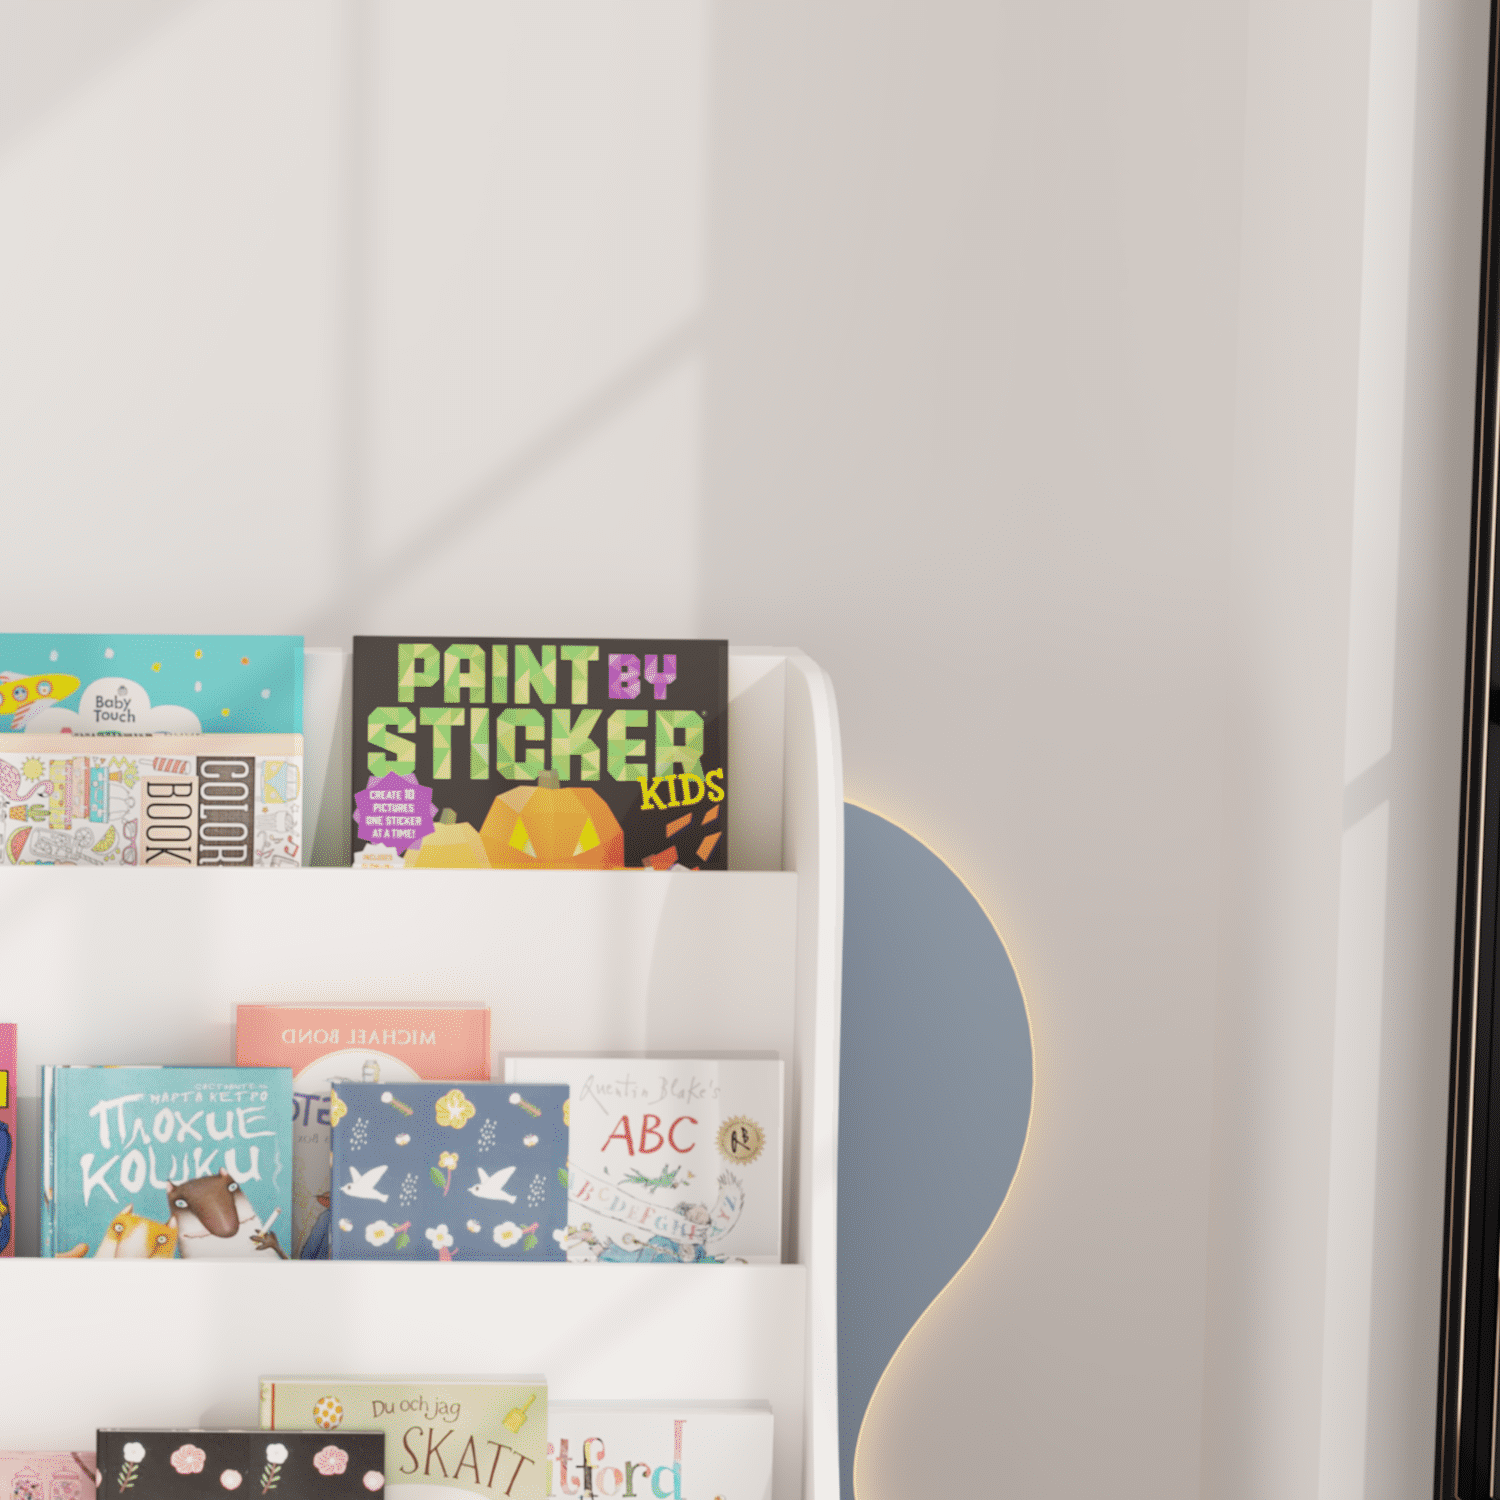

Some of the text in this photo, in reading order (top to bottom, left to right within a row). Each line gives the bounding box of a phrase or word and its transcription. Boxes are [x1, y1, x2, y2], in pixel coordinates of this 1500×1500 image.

[398, 643, 677, 705] PAINT BY
[94, 709, 136, 723] Touch
[95, 695, 131, 711] Baby
[367, 707, 704, 781] STICKER
[369, 789, 415, 800] CREATE 10
[636, 768, 725, 810] KIDS
[146, 782, 192, 864] BOOK
[199, 760, 250, 865] COLOR
[365, 816, 422, 825] ONE STICKER
[373, 803, 415, 813] PICTURES
[372, 829, 382, 838] AT
[384, 829, 390, 838] A
[601, 1113, 698, 1156] ABC
[372, 1396, 461, 1422] Du och jag
[399, 1426, 535, 1497] SKATT
